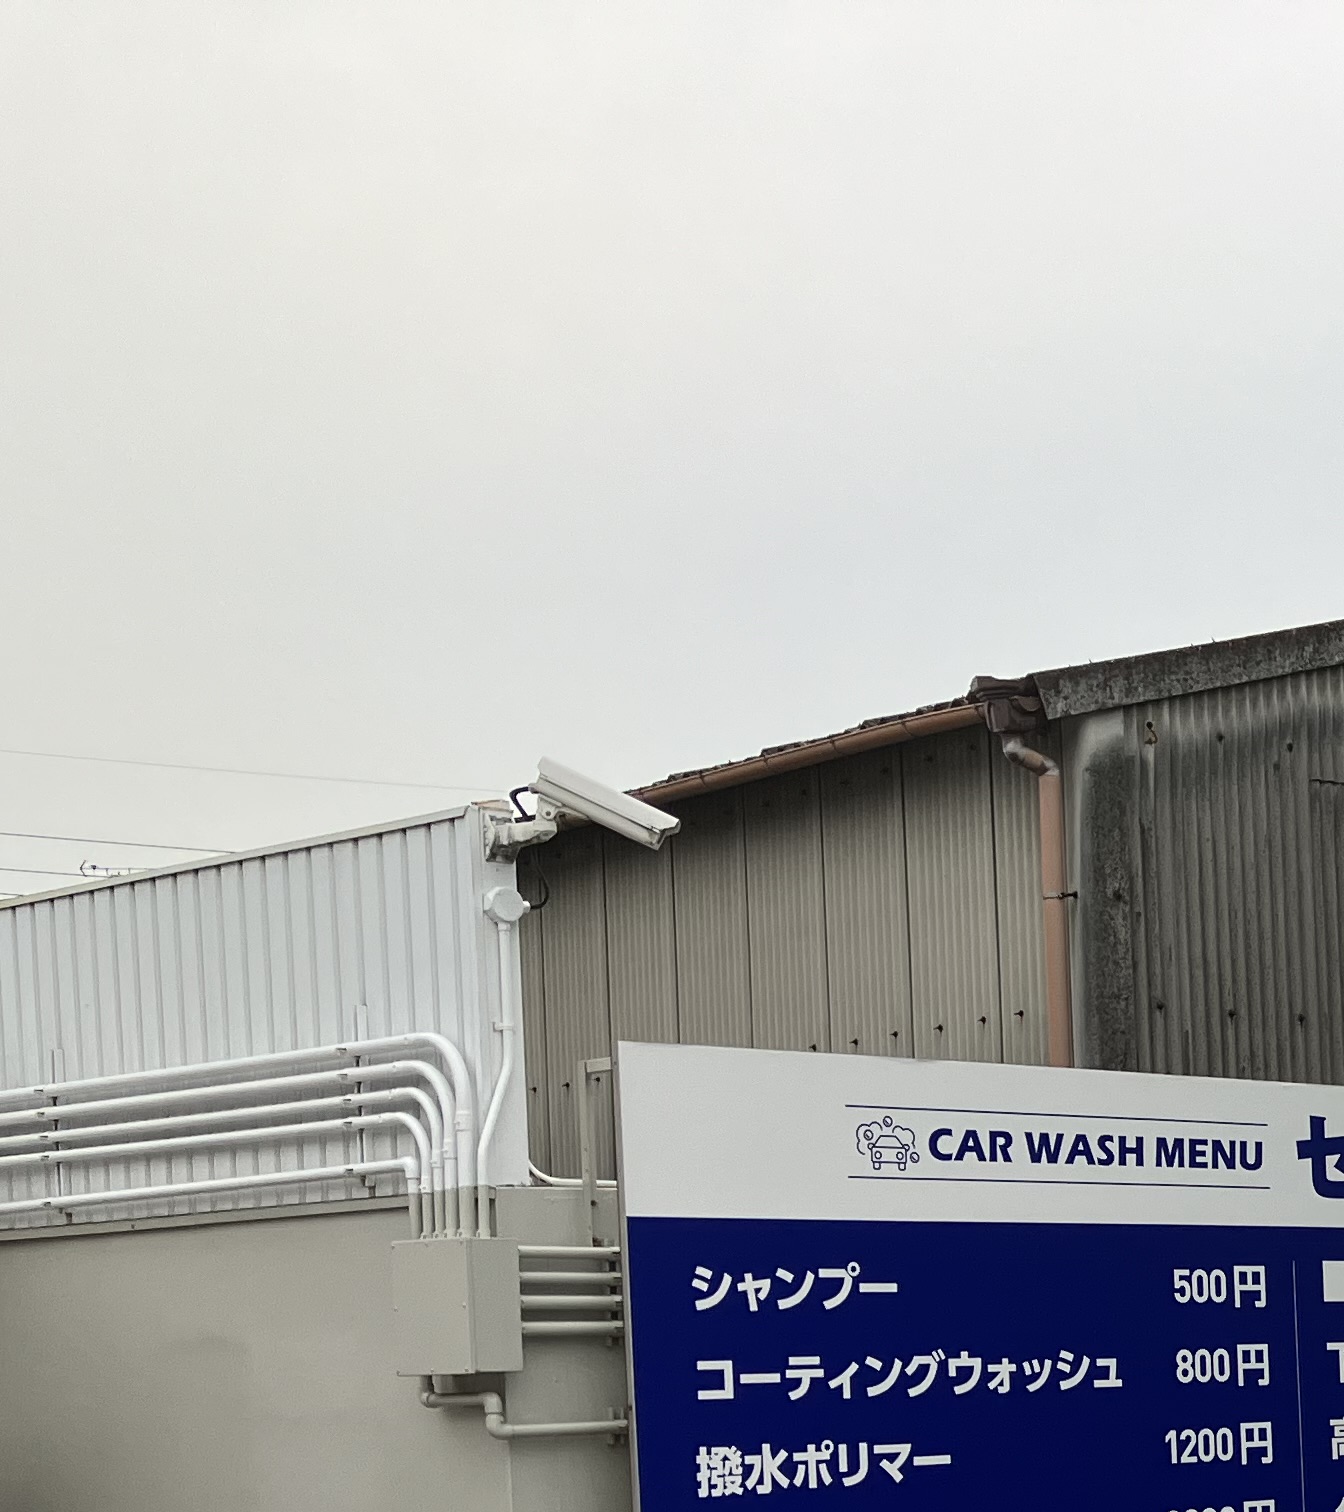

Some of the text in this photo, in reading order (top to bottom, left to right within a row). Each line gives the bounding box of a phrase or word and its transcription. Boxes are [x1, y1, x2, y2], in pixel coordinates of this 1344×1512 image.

[928, 1129, 1263, 1171] CAR WASH MENU
[692, 1261, 1267, 1310] シャンプー 500円
[697, 1343, 1270, 1401] コーティングウォッシュ 800円
[697, 1422, 1274, 1497] 撥水ポリマー 1200円
